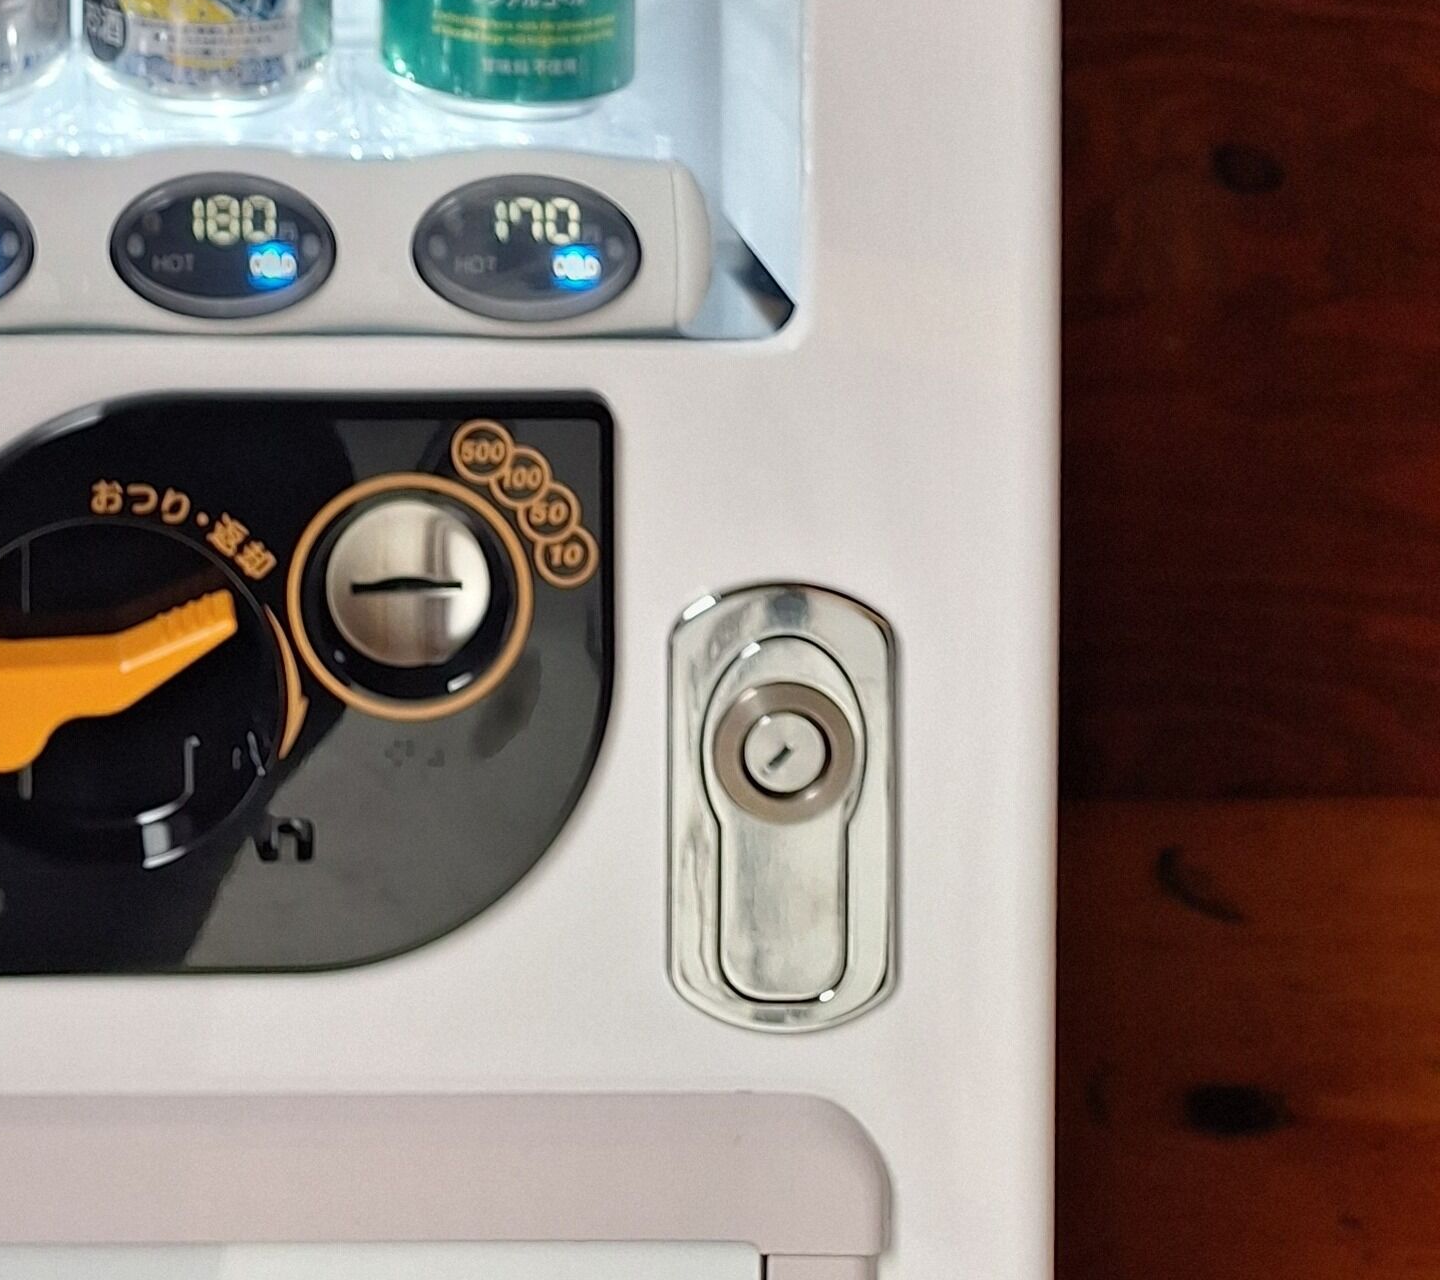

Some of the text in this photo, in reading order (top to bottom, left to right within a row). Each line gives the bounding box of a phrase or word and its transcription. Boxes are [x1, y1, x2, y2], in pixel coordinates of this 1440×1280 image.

[192, 195, 277, 244] 180
[494, 197, 581, 244] 170
[461, 439, 506, 464] 500
[529, 502, 568, 526] 50
[550, 543, 584, 567] 10
